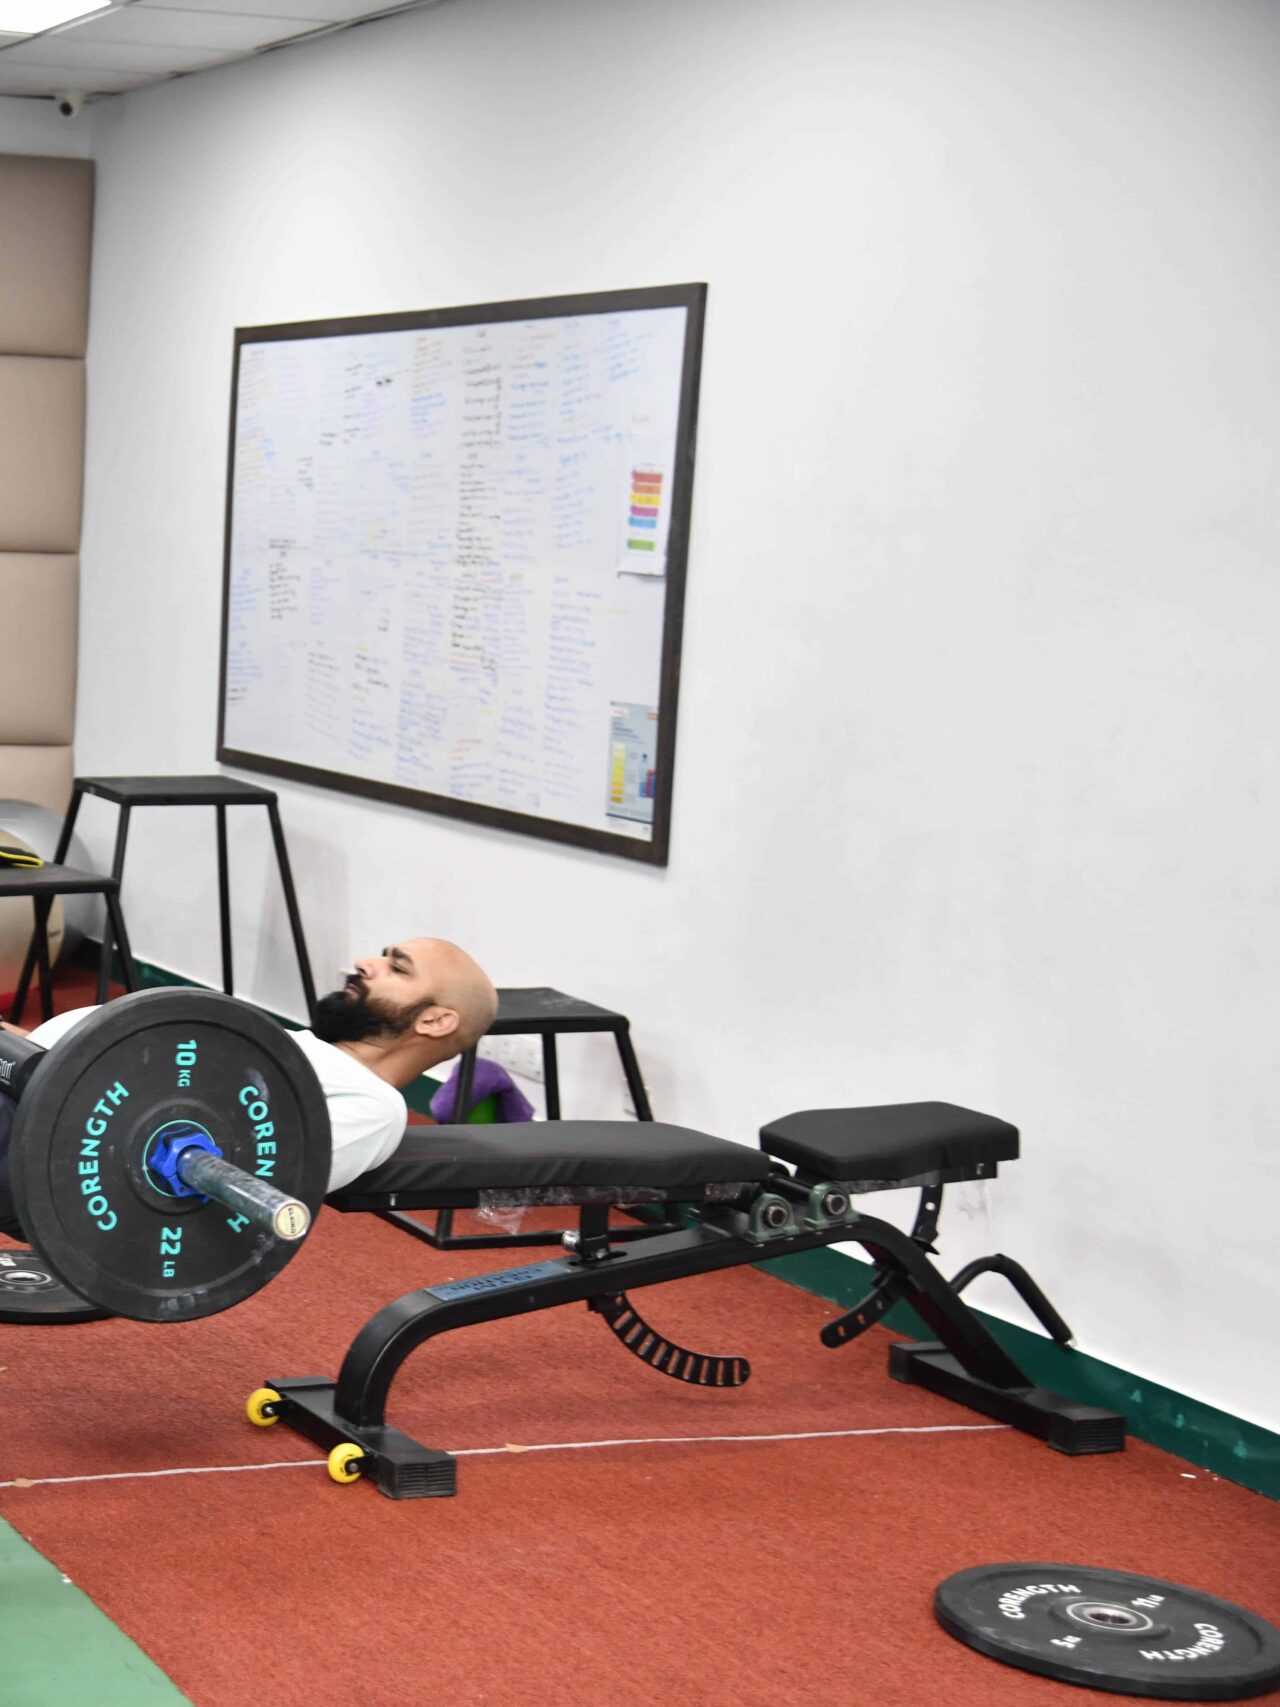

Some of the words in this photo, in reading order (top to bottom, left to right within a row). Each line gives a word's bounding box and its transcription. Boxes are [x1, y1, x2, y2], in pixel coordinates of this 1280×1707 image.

[175, 1039, 197, 1065] 10
[177, 1069, 191, 1087] KG
[77, 1081, 130, 1231] CORENGTH
[160, 1226, 183, 1255] 22
[162, 1260, 176, 1278] LB
[998, 1584, 1082, 1619] CORENGTH
[1139, 1623, 1225, 1660] CORENGTH
